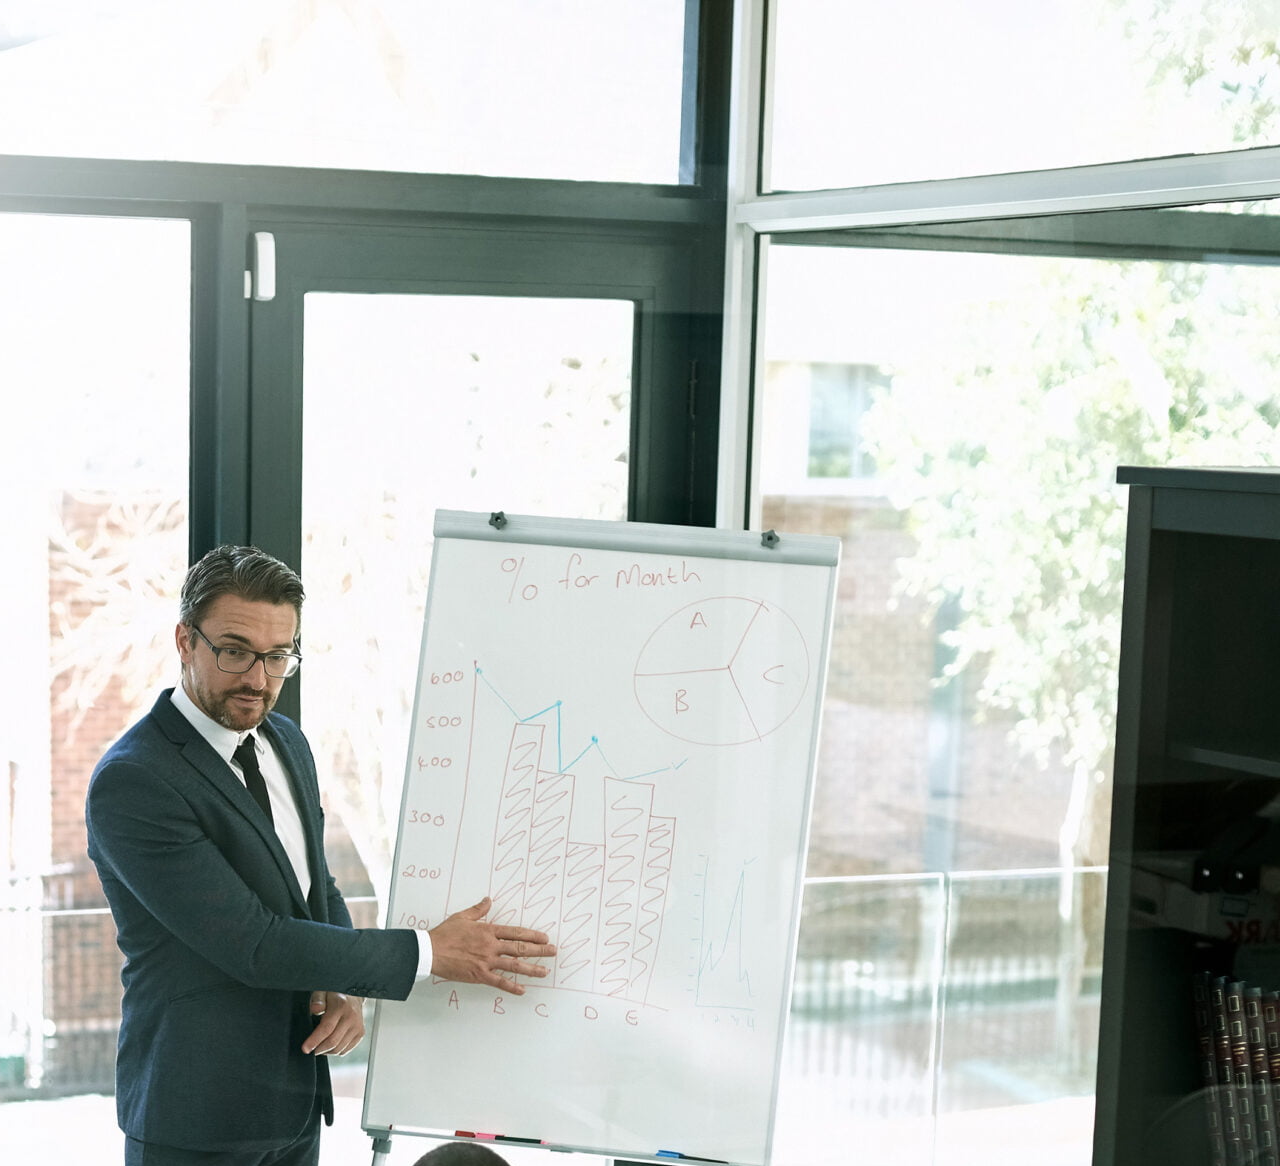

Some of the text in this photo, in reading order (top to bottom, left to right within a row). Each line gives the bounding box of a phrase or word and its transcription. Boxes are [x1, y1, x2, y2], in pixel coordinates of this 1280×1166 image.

[500, 556, 538, 603] %
[558, 553, 599, 590] for
[689, 611, 708, 629] A
[430, 670, 464, 685] 600
[762, 664, 785, 685] C
[675, 688, 690, 715] B
[426, 715, 462, 729] 500
[407, 809, 445, 827] 300
[402, 864, 441, 879] 200
[398, 912, 430, 931] 100
[448, 989, 639, 1026] A B C D E
